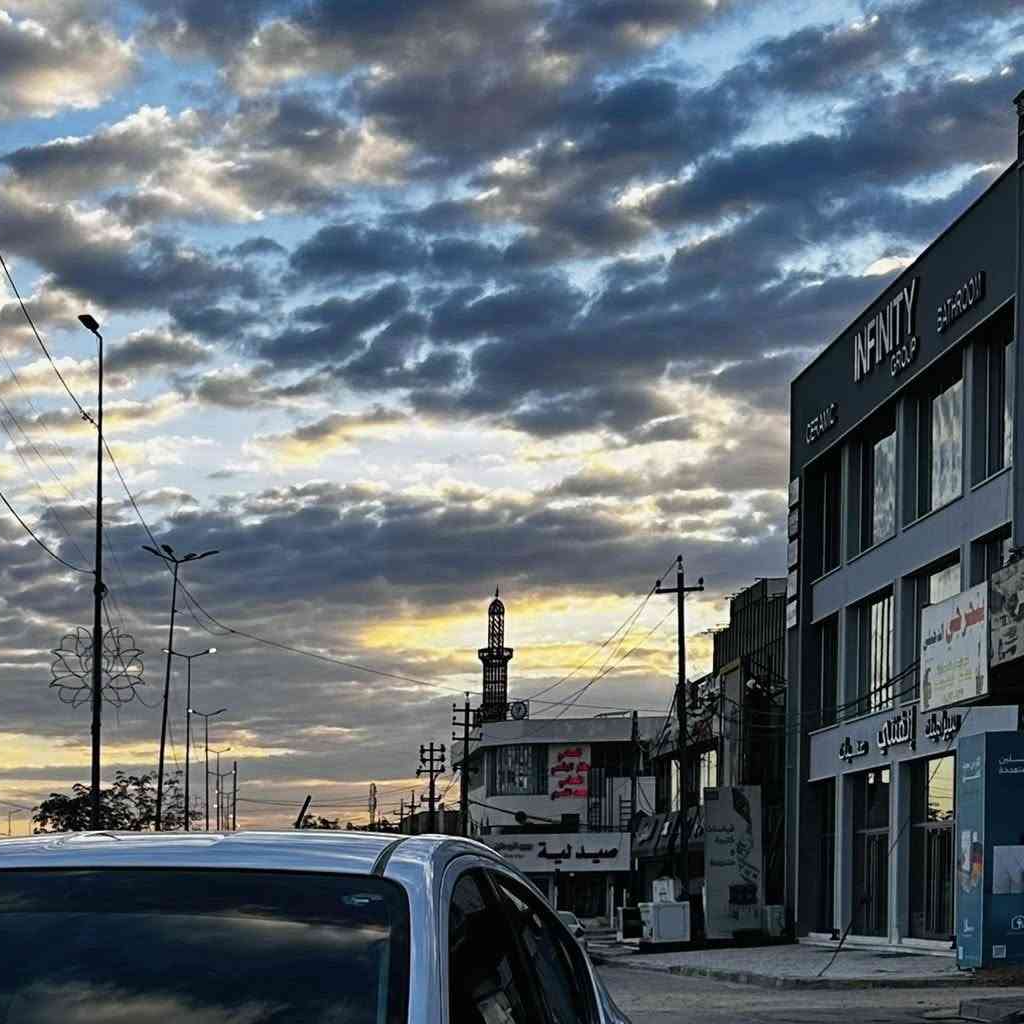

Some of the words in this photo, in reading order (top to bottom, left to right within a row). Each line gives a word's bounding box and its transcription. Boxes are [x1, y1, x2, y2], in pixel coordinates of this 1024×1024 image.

[936, 271, 986, 334] BATHROOM
[853, 277, 918, 384] INFINITY
[889, 336, 919, 378] GROUP
[538, 841, 619, 865] صيدلية
